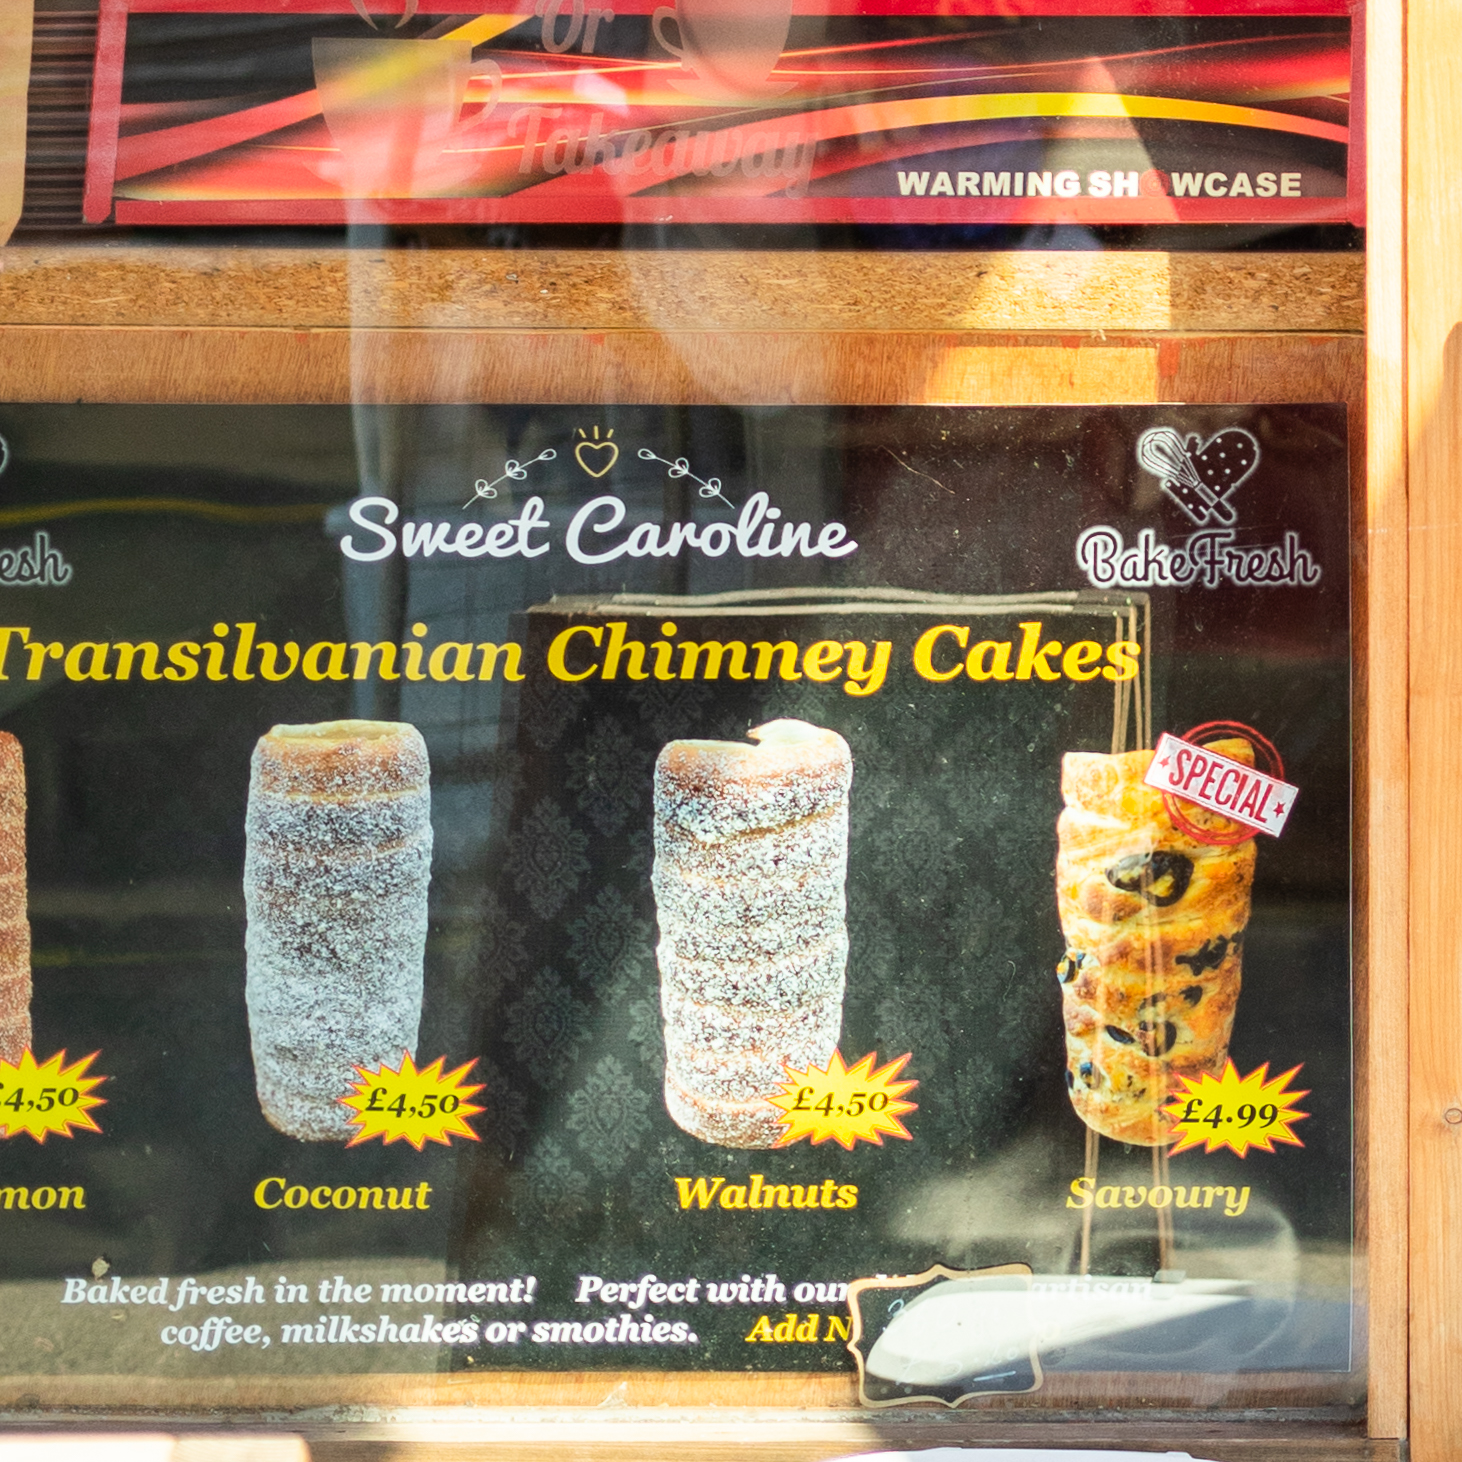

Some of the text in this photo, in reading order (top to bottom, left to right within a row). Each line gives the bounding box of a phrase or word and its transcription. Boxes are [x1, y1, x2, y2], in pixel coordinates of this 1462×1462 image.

[505, 106, 820, 201] Takeaway
[899, 170, 1081, 198] WARMING
[340, 492, 860, 566] Sweet Caroline
[1076, 525, 1322, 589] BakeFresh
[546, 621, 894, 698] Chimney
[913, 621, 1142, 683] Cakes
[1167, 747, 1274, 825] SPECIAL
[364, 1085, 461, 1118] £4,50
[792, 1087, 890, 1117] £4,50
[1181, 1096, 1280, 1130] £4.99
[253, 1176, 433, 1212] Coconut
[673, 1174, 860, 1210] Walnuts
[1065, 1176, 1252, 1217] Savoury
[61, 1275, 169, 1306] Baked
[167, 1277, 266, 1312] fresh
[273, 1276, 303, 1305] in
[317, 1276, 373, 1305] the
[380, 1275, 537, 1306] moment!
[576, 1275, 700, 1310] Perfect
[706, 1274, 788, 1305] with
[160, 1314, 699, 1352] coffee, milkshakes or smothies.
[745, 1314, 820, 1344] Add
